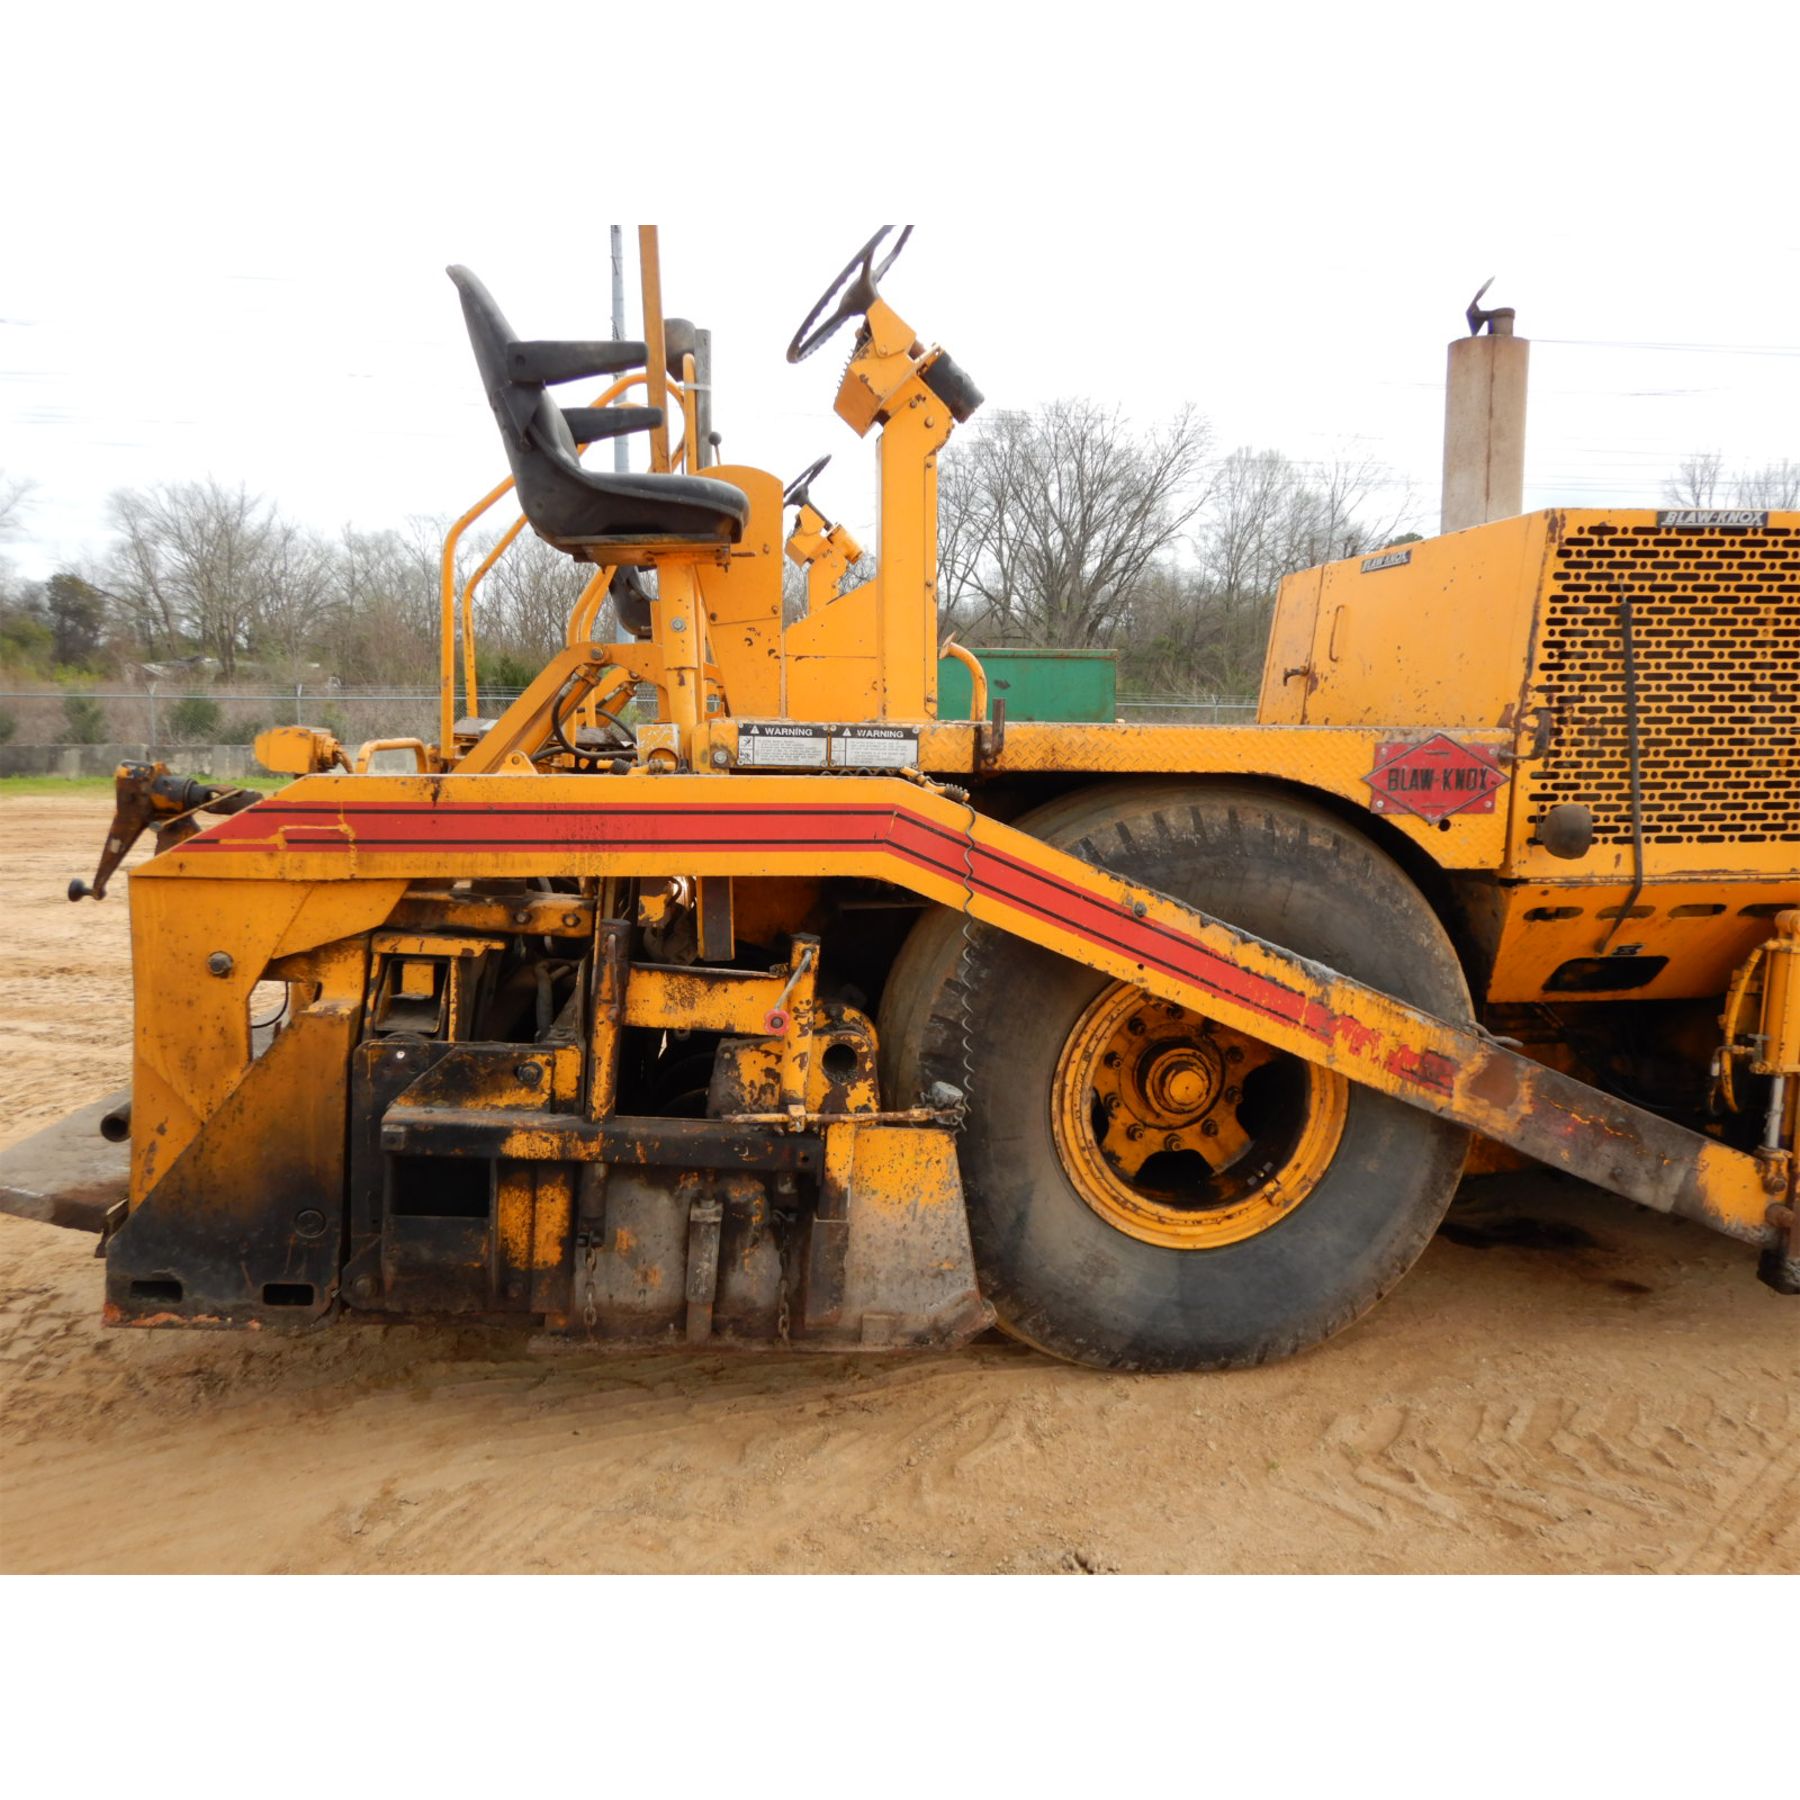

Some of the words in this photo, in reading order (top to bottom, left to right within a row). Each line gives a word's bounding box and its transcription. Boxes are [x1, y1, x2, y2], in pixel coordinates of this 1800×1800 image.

[1662, 511, 1763, 525] BLAW-KNOX
[765, 726, 813, 737] WARNING
[856, 728, 904, 738] WARNING
[1387, 767, 1489, 792] BLAW-KNOX
